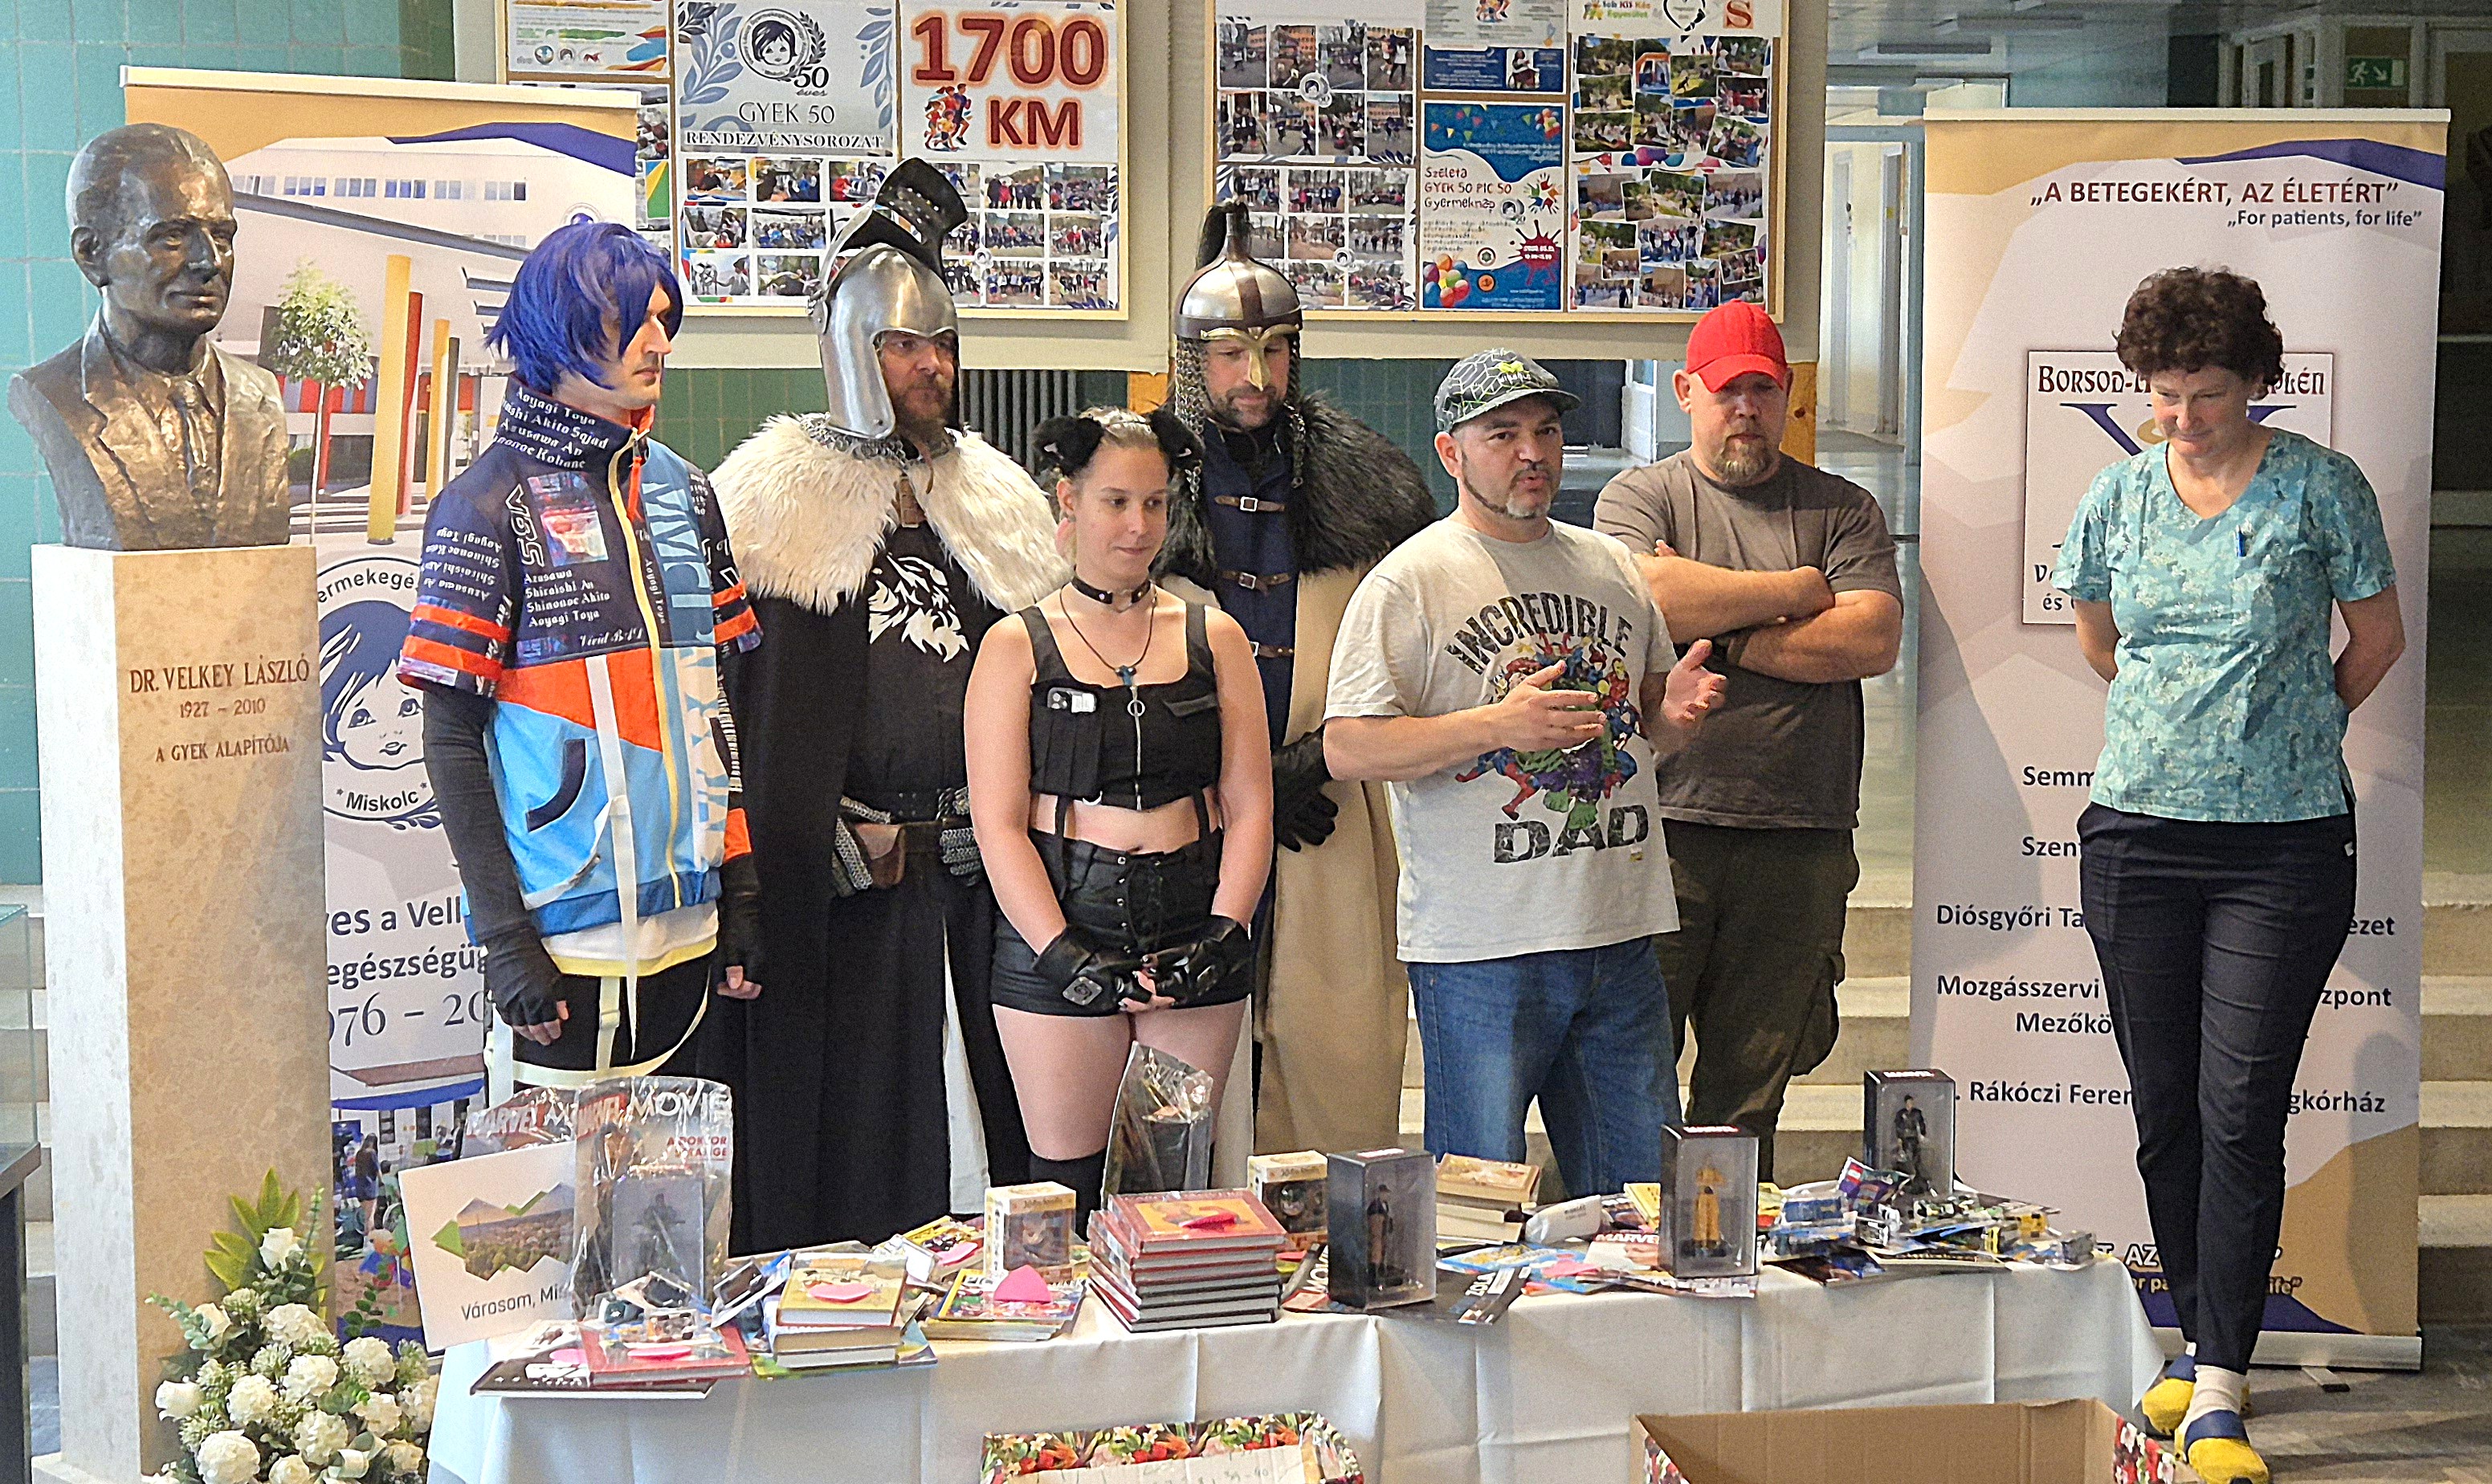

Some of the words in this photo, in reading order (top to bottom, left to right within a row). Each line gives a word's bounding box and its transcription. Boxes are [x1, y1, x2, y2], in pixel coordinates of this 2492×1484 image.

[915, 16, 1105, 85] 1700
[793, 67, 830, 88] 50
[739, 102, 799, 124] GYEK
[808, 104, 835, 124] 50
[989, 100, 1079, 146] KM
[686, 132, 883, 149] RENDEZVÉNYSOROZAT
[2070, 177, 2233, 206] BETEGEKÉRT,
[2241, 183, 2274, 203] AZ
[2272, 211, 2350, 229] patients,
[2355, 211, 2380, 226] for
[318, 568, 414, 603] ermekegé
[2042, 593, 2063, 611] és
[1443, 592, 1633, 675] INCREDIBLE
[129, 669, 159, 693] DR.
[163, 663, 235, 690] VELKEY
[244, 652, 310, 686] LÁSZLÓ
[180, 700, 210, 719] 1927
[234, 697, 266, 716] 2010
[156, 747, 165, 762] A
[171, 742, 208, 762] GYEK
[215, 732, 290, 758] ALAPÍTÓJA
[345, 790, 419, 812] Miskolc
[1494, 804, 1649, 864] DAD
[2021, 836, 2082, 857] Szen
[330, 909, 371, 936] es
[381, 910, 397, 931] a
[1937, 904, 2050, 932] Diósgyőri
[2058, 907, 2085, 928] Ta
[2348, 916, 2395, 936] ezet
[1937, 975, 2099, 1001] Mozgásszervi
[2321, 987, 2392, 1009] zpont
[329, 991, 386, 1046] 76
[443, 989, 484, 1026] 20
[2016, 1012, 2112, 1034] Mezőkö
[1970, 1079, 2061, 1103] Rákóczi
[2289, 1088, 2385, 1115] gkórház
[1594, 1233, 1660, 1245] MARVE
